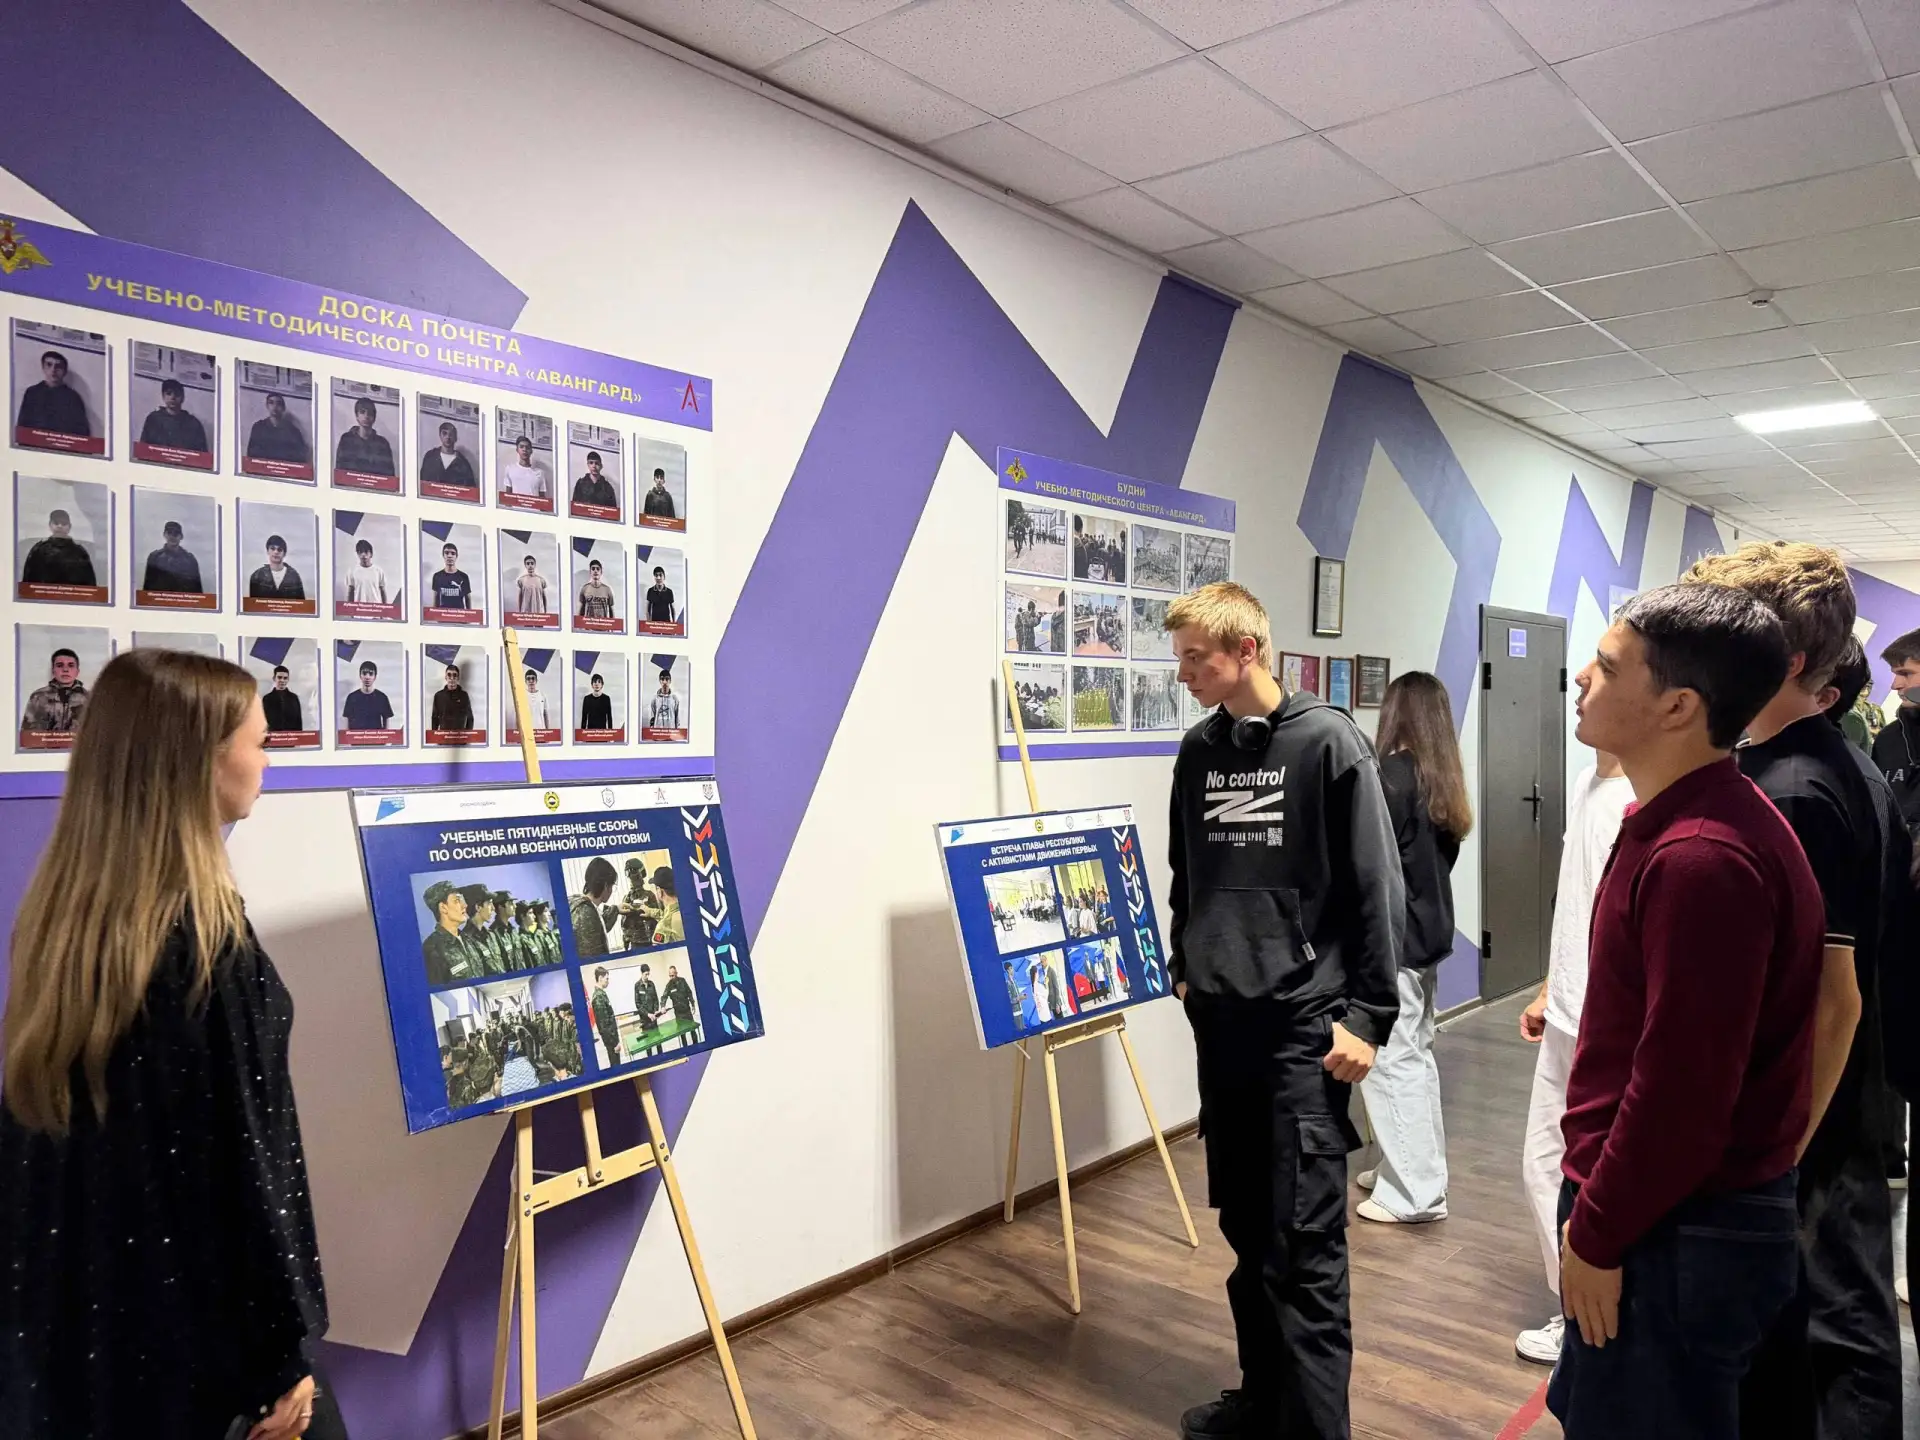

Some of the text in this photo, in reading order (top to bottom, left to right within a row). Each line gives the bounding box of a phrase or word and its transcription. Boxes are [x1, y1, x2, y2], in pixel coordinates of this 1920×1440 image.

[87, 273, 643, 404] УЧЕБНО-МЕТОДИЧЕСКОГО ЦЕНТРА «АВАНГАРД»
[319, 296, 523, 356] ДОСКА ПОЧЕТА
[1035, 480, 1135, 509] УЧЕБНО-МЕТОДИЧЕСКОГО
[1136, 502, 1165, 515] ЦЕНТРА
[1117, 481, 1146, 498] БУДНИ
[1205, 765, 1286, 789] No control
[440, 818, 638, 845] УЧЕБНЫЕ ПЯТИДНЕВНЫЕ СБОРЫ
[990, 835, 1086, 855] ВСТРЕЧА ГЛАВЫ РЕСПУБЛИКИ
[429, 832, 651, 862] ПО ОСНОВАМ ВОЕННОЙ ПОДГОТОВКИ
[981, 844, 1098, 868] С АКТИВИСТАМИ ДВИЖЕНИЯ ПЕРВЫХ
